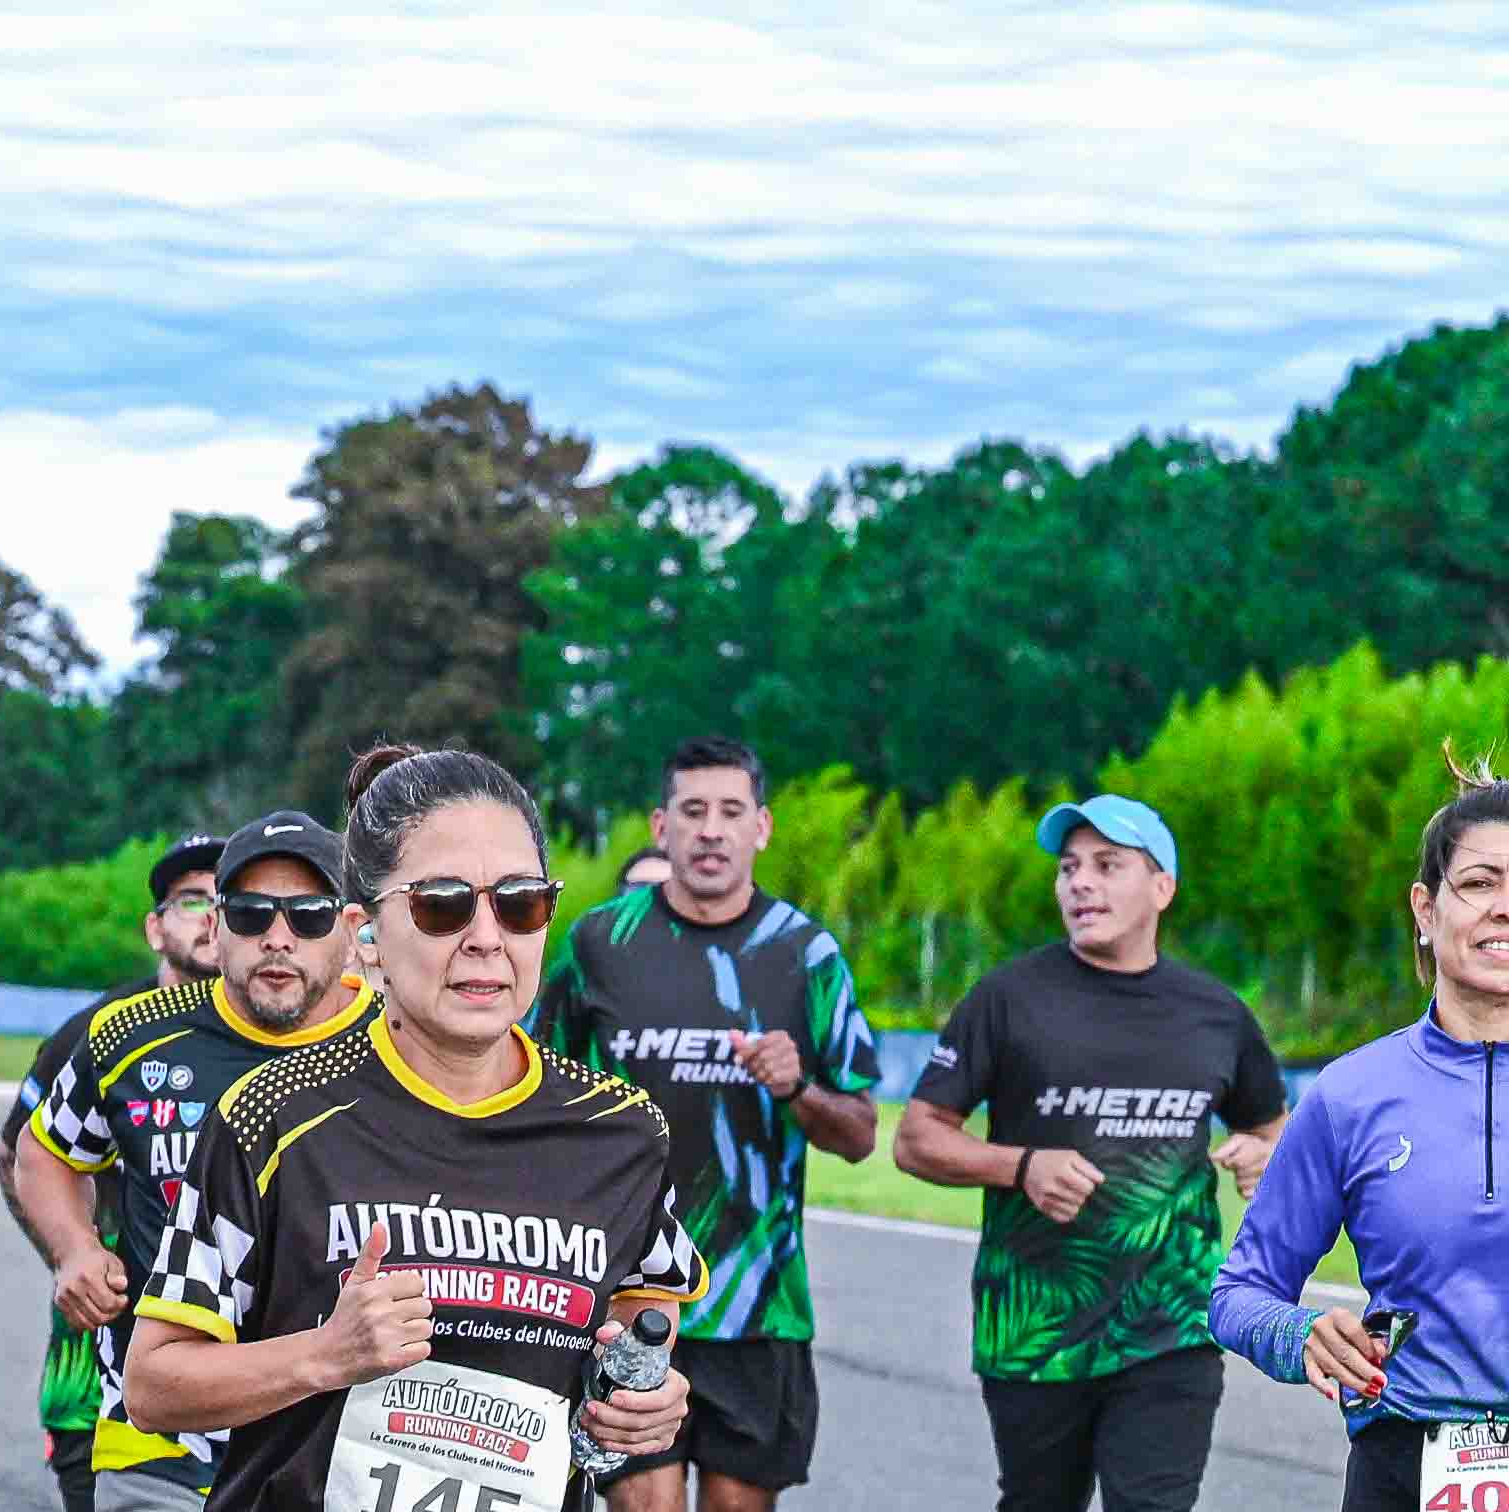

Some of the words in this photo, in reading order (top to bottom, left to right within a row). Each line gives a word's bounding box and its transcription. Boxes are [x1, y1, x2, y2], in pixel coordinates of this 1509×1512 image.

[501, 1272, 573, 1318] RACE
[456, 1320, 511, 1341] Clubes
[514, 1323, 541, 1344] del
[382, 1378, 547, 1442] AUTÓDROMO
[369, 1431, 381, 1441] La
[382, 1434, 417, 1450] Carrera
[418, 1442, 431, 1453] de
[432, 1443, 446, 1457] los
[447, 1448, 478, 1465] Clubes
[479, 1456, 494, 1469] del
[495, 1460, 535, 1478] Noroeste
[404, 1415, 472, 1442] RUNNING
[474, 1427, 516, 1456] RACE
